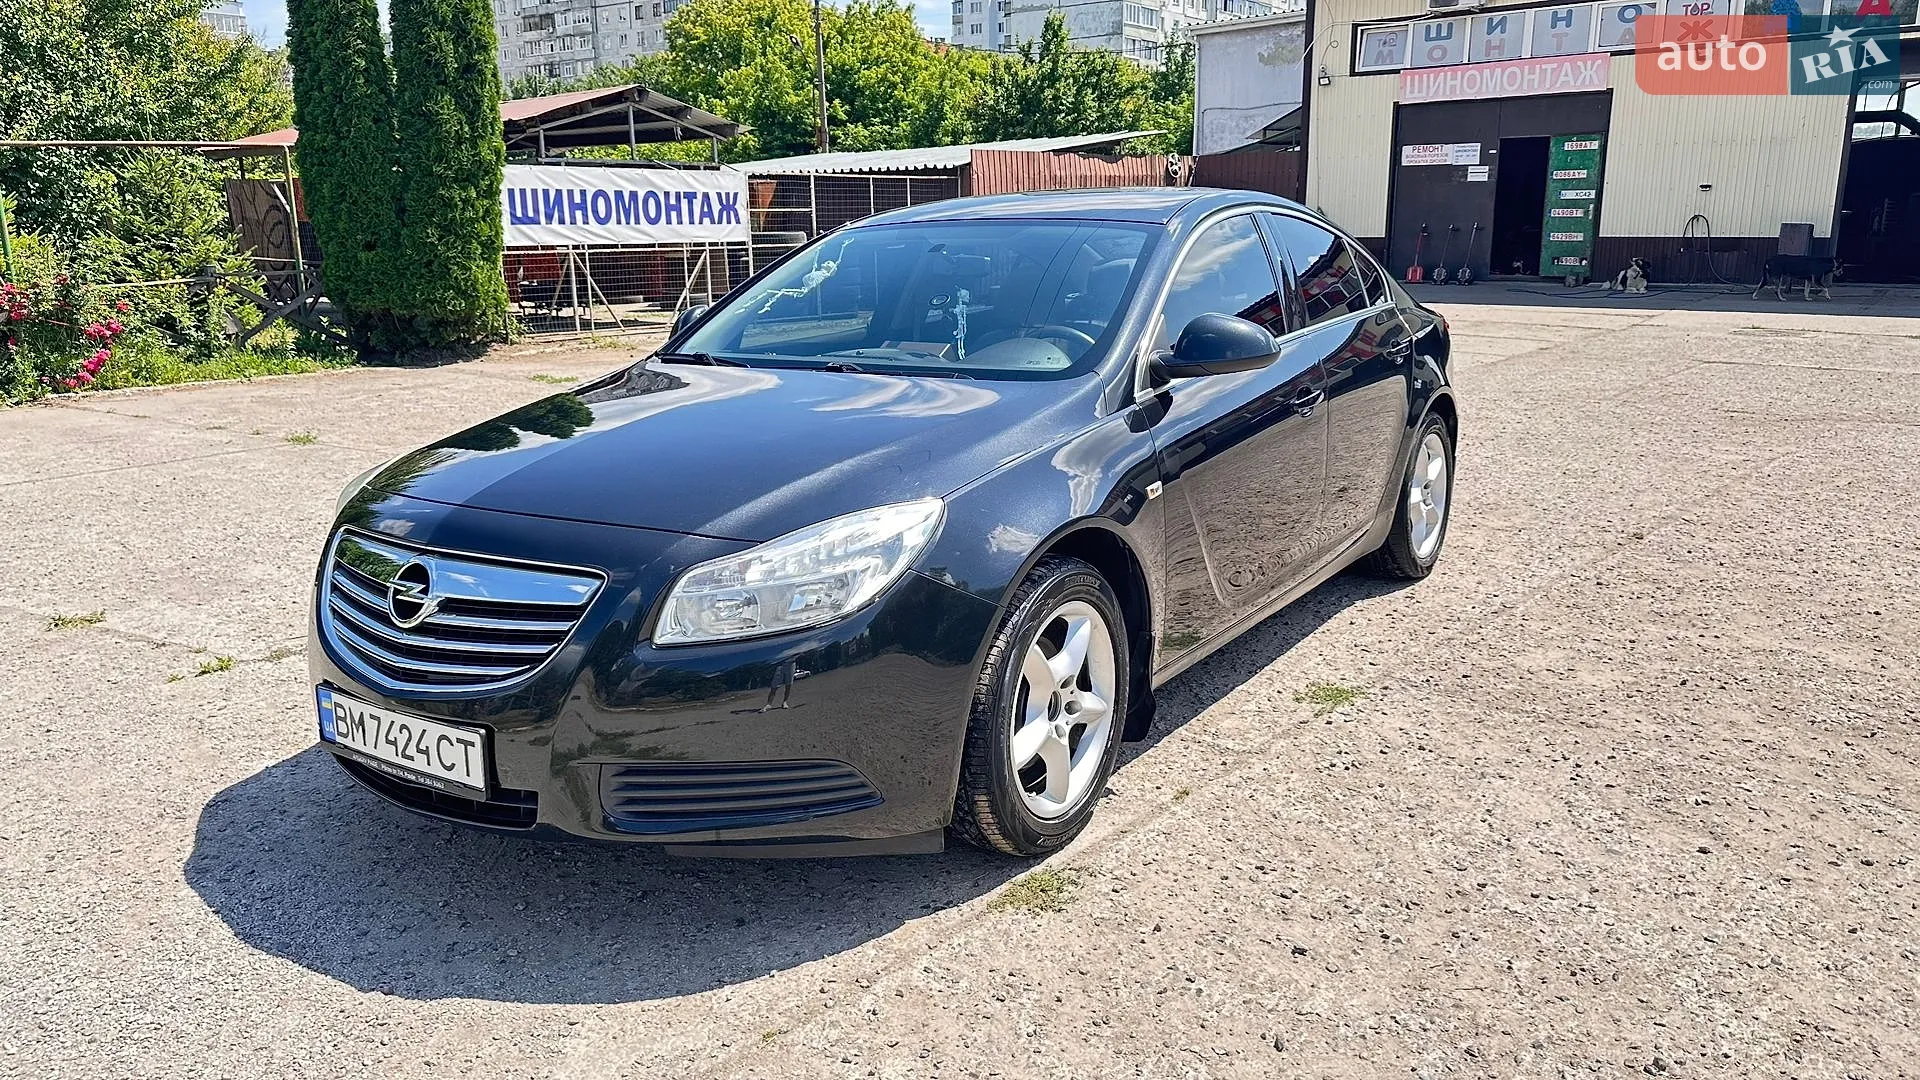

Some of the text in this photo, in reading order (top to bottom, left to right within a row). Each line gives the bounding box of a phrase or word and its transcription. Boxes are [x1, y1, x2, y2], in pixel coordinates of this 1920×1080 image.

[1405, 59, 1602, 99] ШИНОМОНТАЖ
[1411, 145, 1444, 154] РЕМОНТ
[507, 188, 741, 226] ШИНОМОНТАЖ
[324, 720, 335, 733] UA
